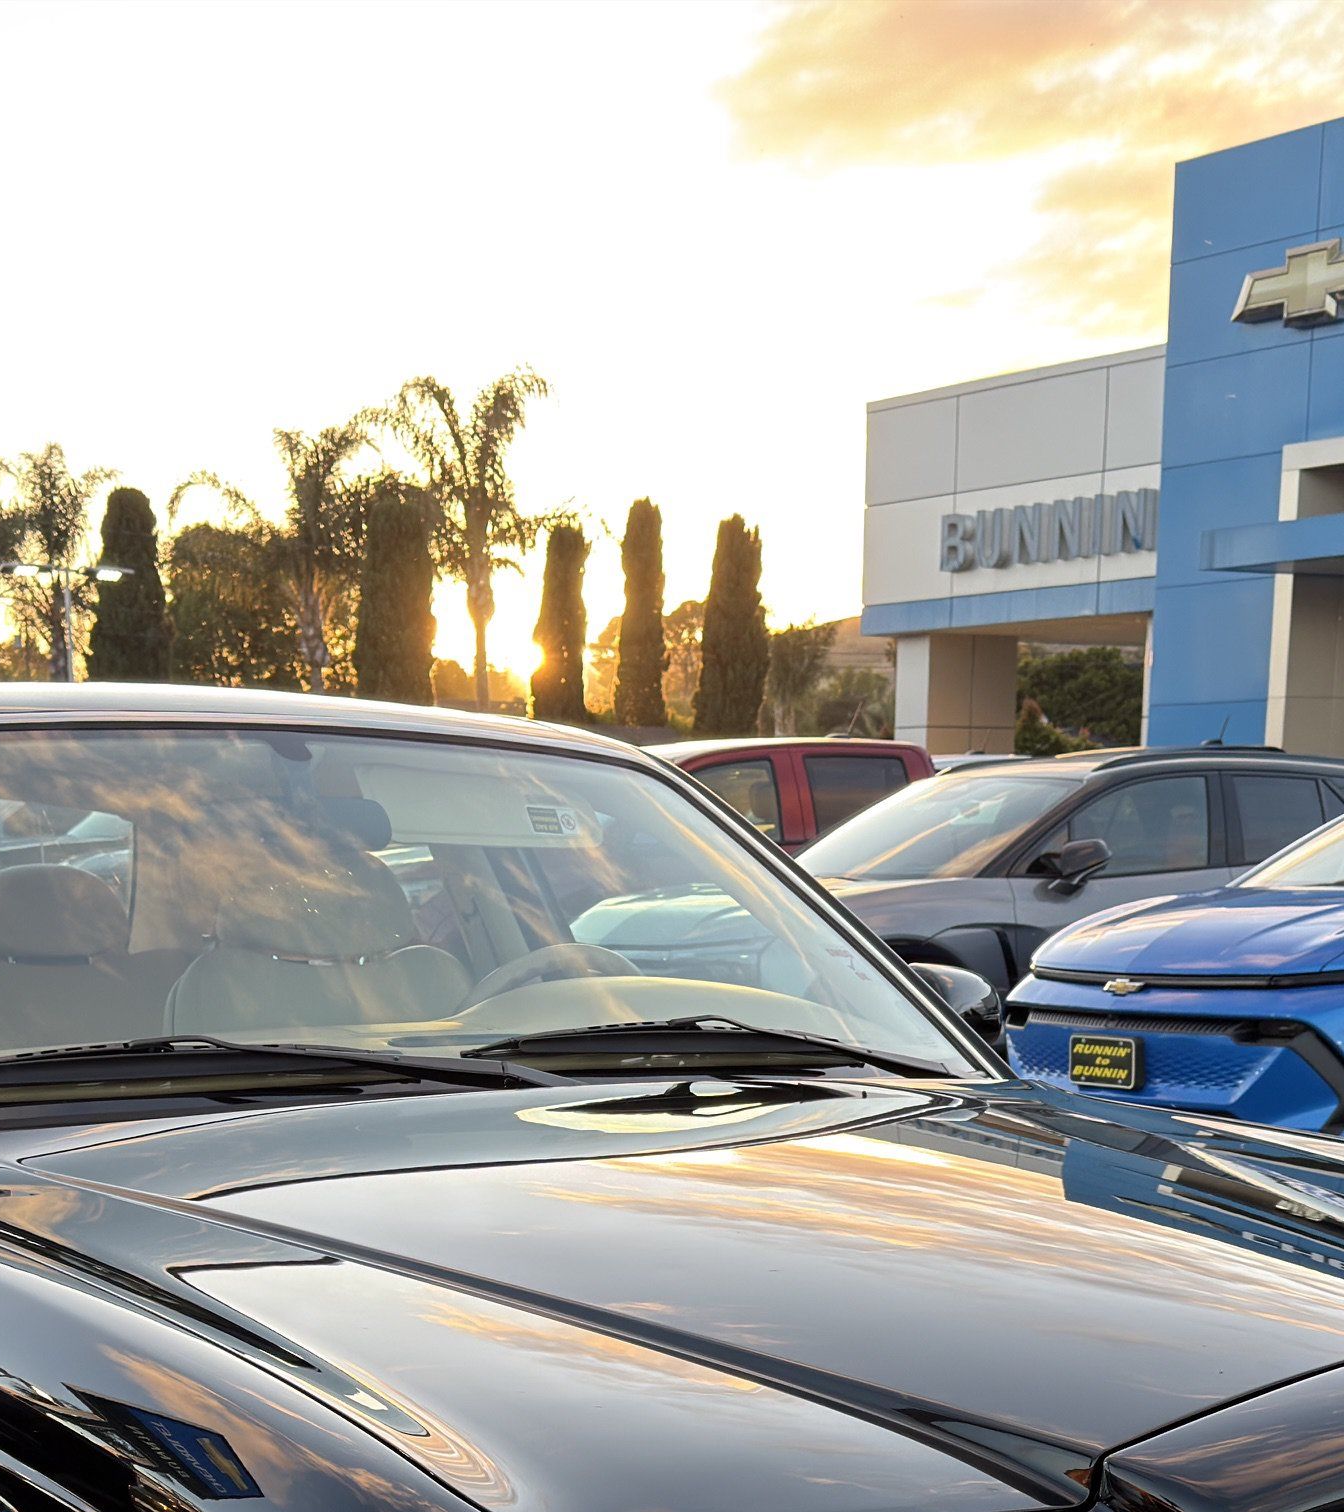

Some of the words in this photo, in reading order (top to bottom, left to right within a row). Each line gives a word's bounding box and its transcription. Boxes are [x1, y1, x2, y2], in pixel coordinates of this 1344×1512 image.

[941, 488, 1158, 572] BUNNIN
[1074, 1044, 1130, 1056] RUNNIN'
[1095, 1056, 1110, 1065] to
[1073, 1066, 1127, 1078] BUNNIN
